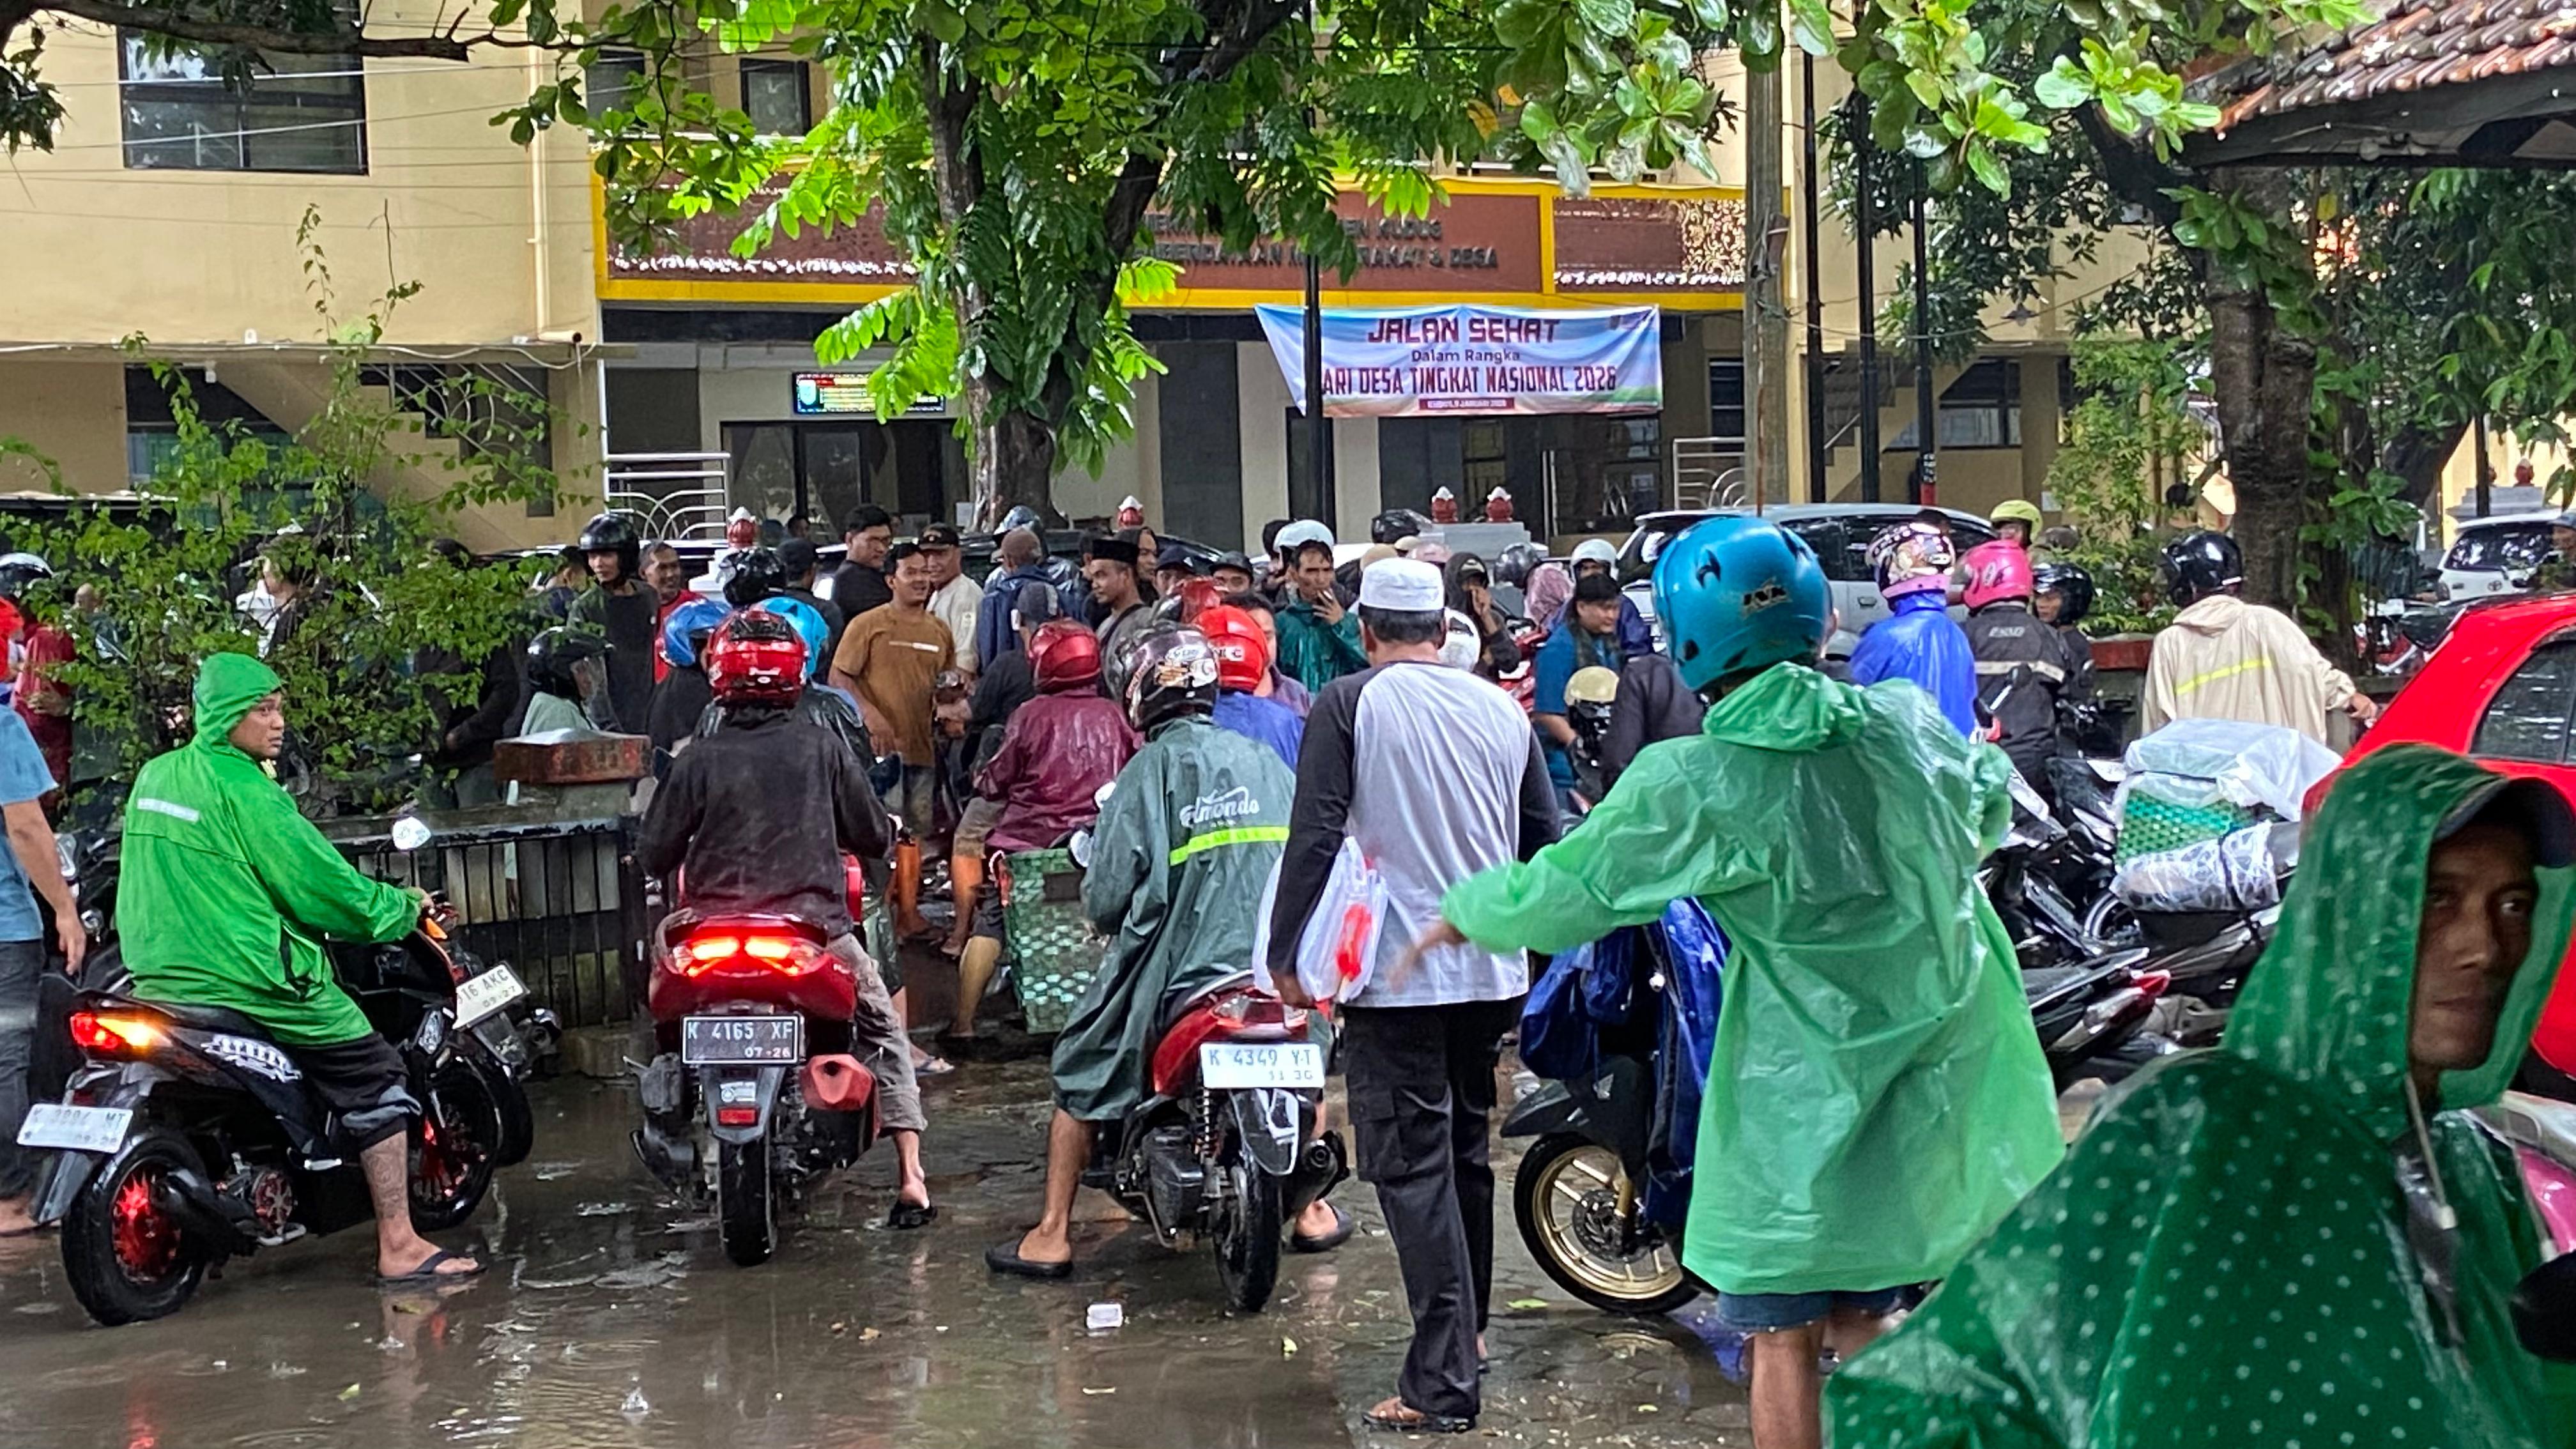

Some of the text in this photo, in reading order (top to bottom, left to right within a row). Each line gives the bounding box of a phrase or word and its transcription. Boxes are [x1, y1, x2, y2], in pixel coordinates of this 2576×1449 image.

[1450, 247, 1498, 267] DESA
[1367, 317, 1560, 343] JALAN SEHAT
[1412, 349, 1520, 364] Dalam Rangka
[1322, 367, 1353, 395] ARI
[1360, 367, 1404, 394] DESA
[1409, 367, 1479, 394] TINGKAT
[1486, 366, 1568, 393] NASIONAL
[482, 969, 509, 990] AKC
[687, 1022, 793, 1040] K 4165 XF
[1209, 1050, 1220, 1066] K
[1234, 1050, 1278, 1066] 4349
